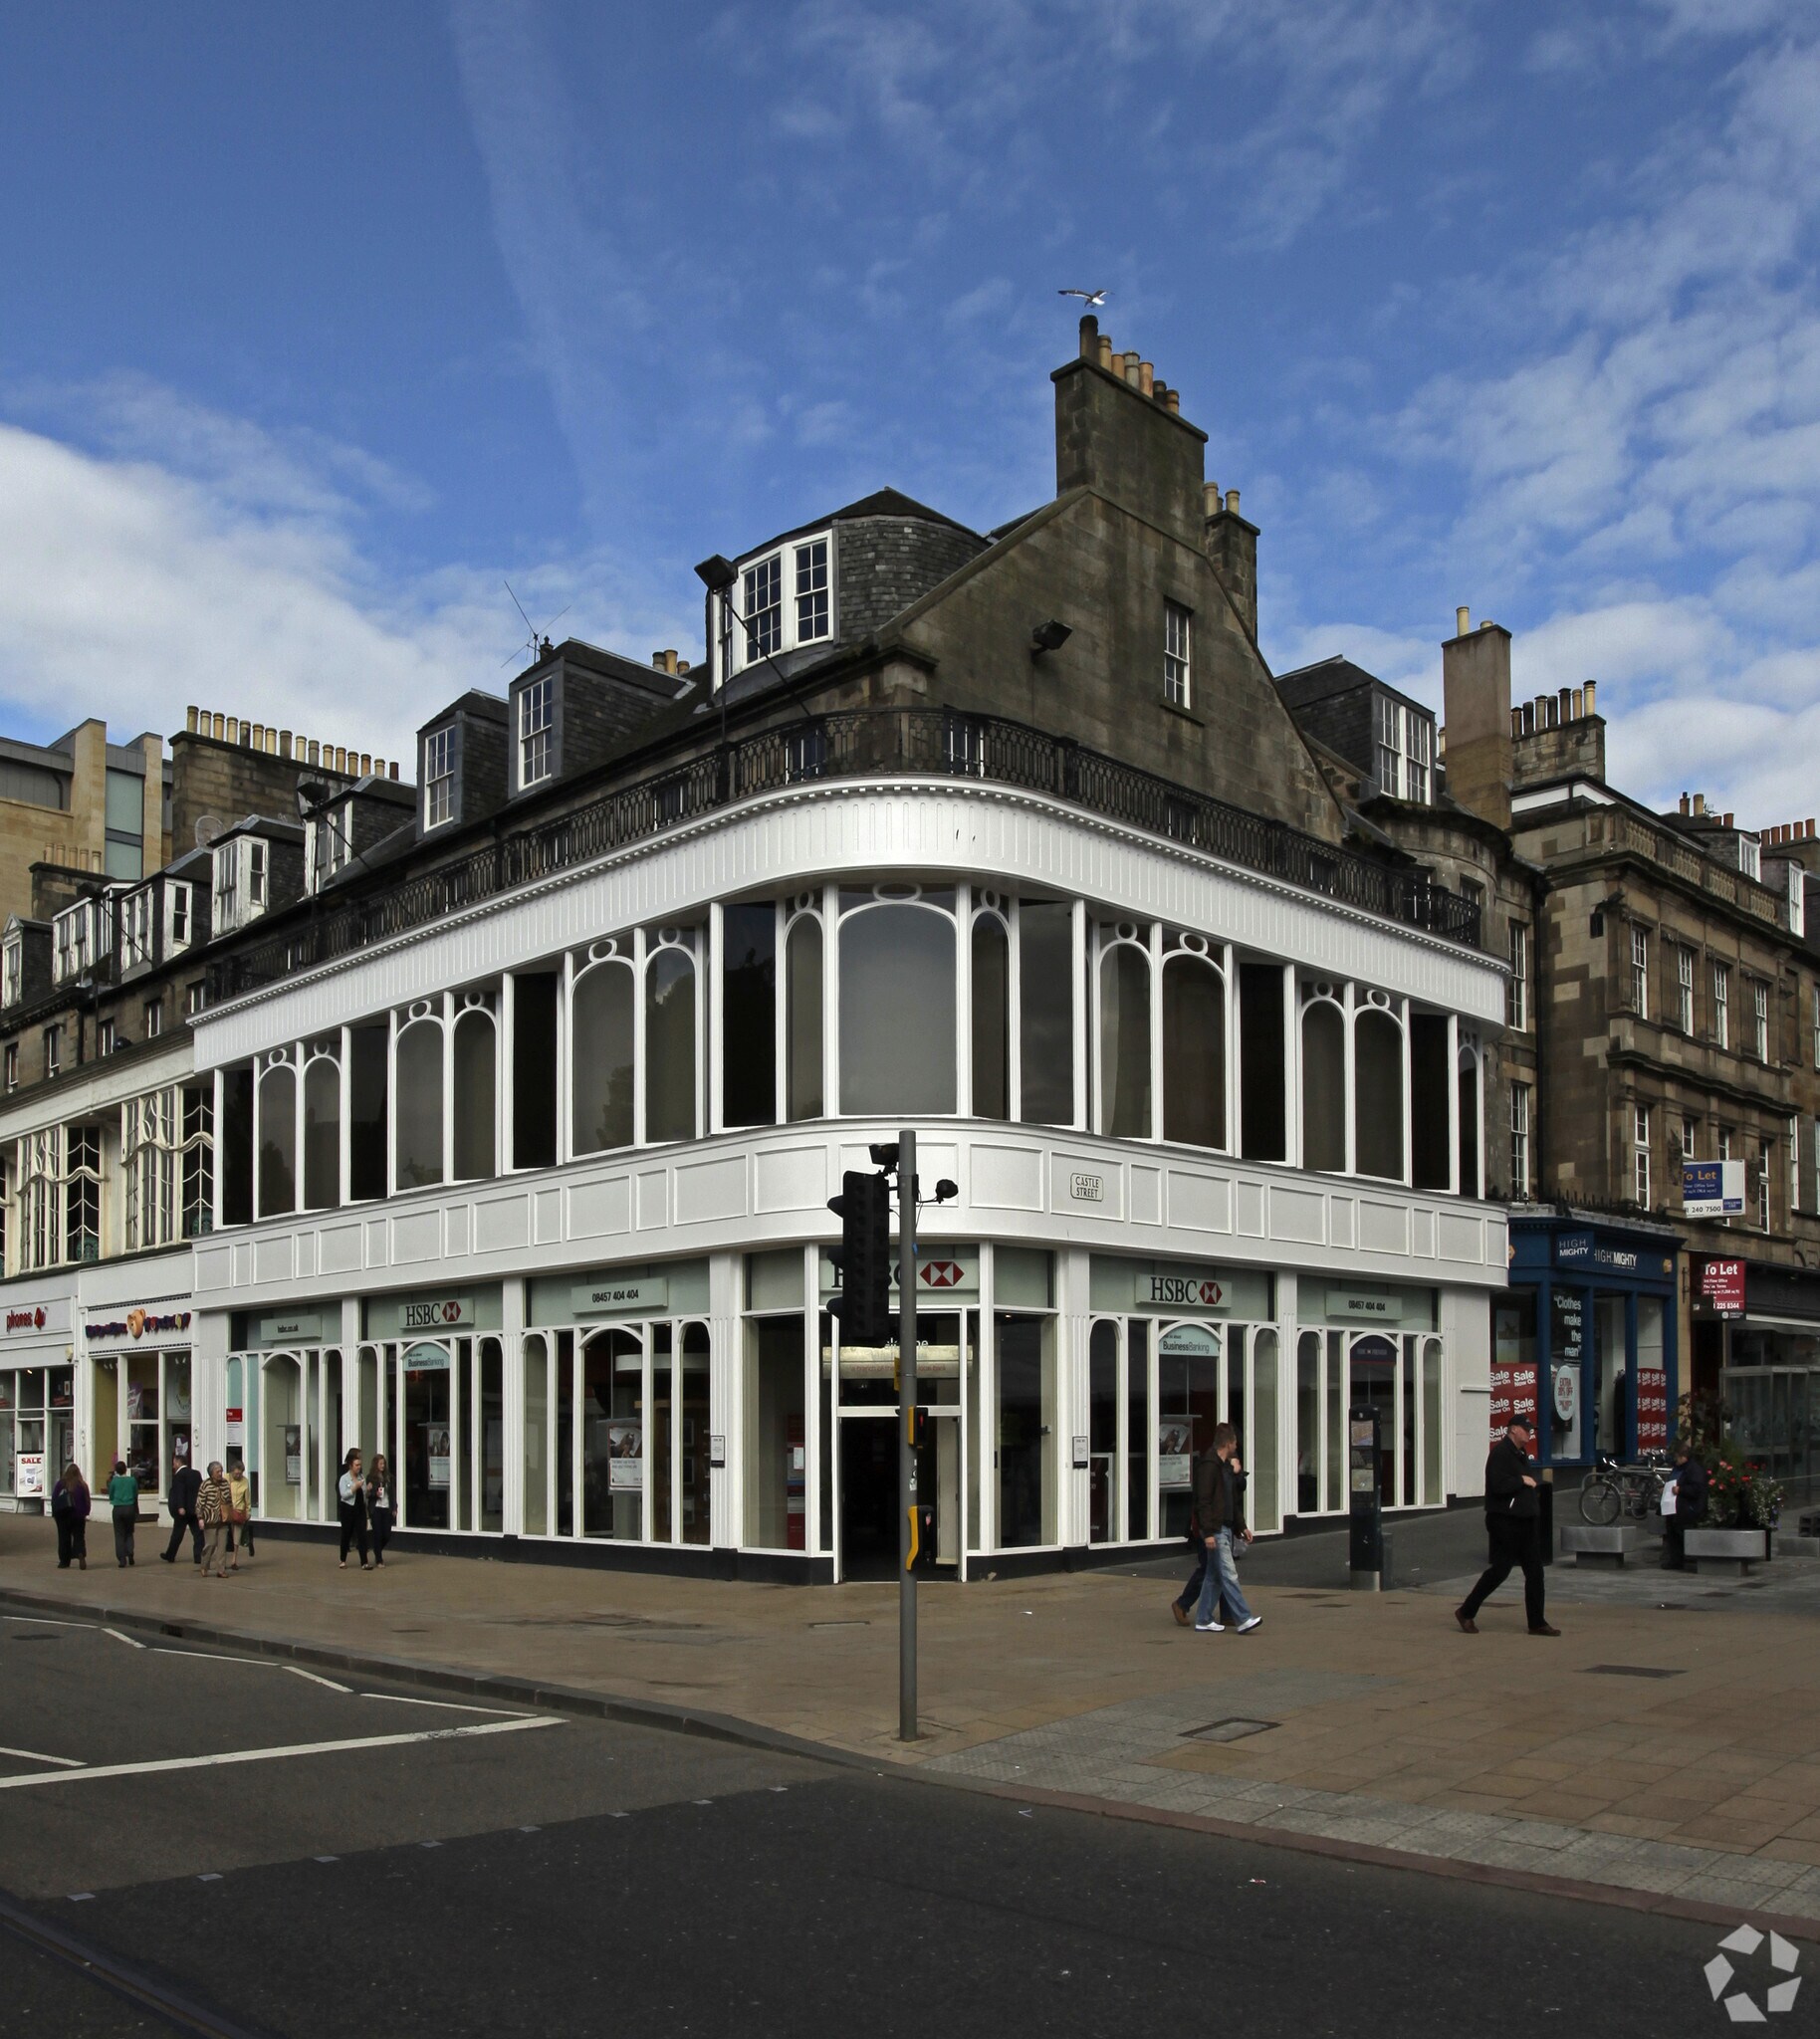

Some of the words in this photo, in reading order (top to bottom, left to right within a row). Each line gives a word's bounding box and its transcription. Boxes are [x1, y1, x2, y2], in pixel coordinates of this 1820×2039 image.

[1698, 1170, 1717, 1181] Let
[1075, 1176, 1099, 1188] CASTLE
[1076, 1187, 1098, 1199] STREET
[1559, 1239, 1587, 1248] HIGH
[1559, 1246, 1589, 1256] MIGHTY
[1705, 1263, 1717, 1275] To
[1719, 1263, 1738, 1275] Let
[591, 1291, 611, 1303] 08457
[613, 1290, 625, 1301] 404
[626, 1288, 639, 1299] 404
[1150, 1276, 1198, 1304] HSBC
[1348, 1299, 1364, 1309] 08457
[1365, 1301, 1375, 1311] 404
[1376, 1302, 1386, 1312] 404
[405, 1302, 441, 1327] HSBC
[1564, 1313, 1581, 1326] make
[7, 1310, 33, 1334] phones
[1571, 1329, 1581, 1342] the
[1513, 1370, 1534, 1382] Sale
[1513, 1398, 1534, 1410] Sale
